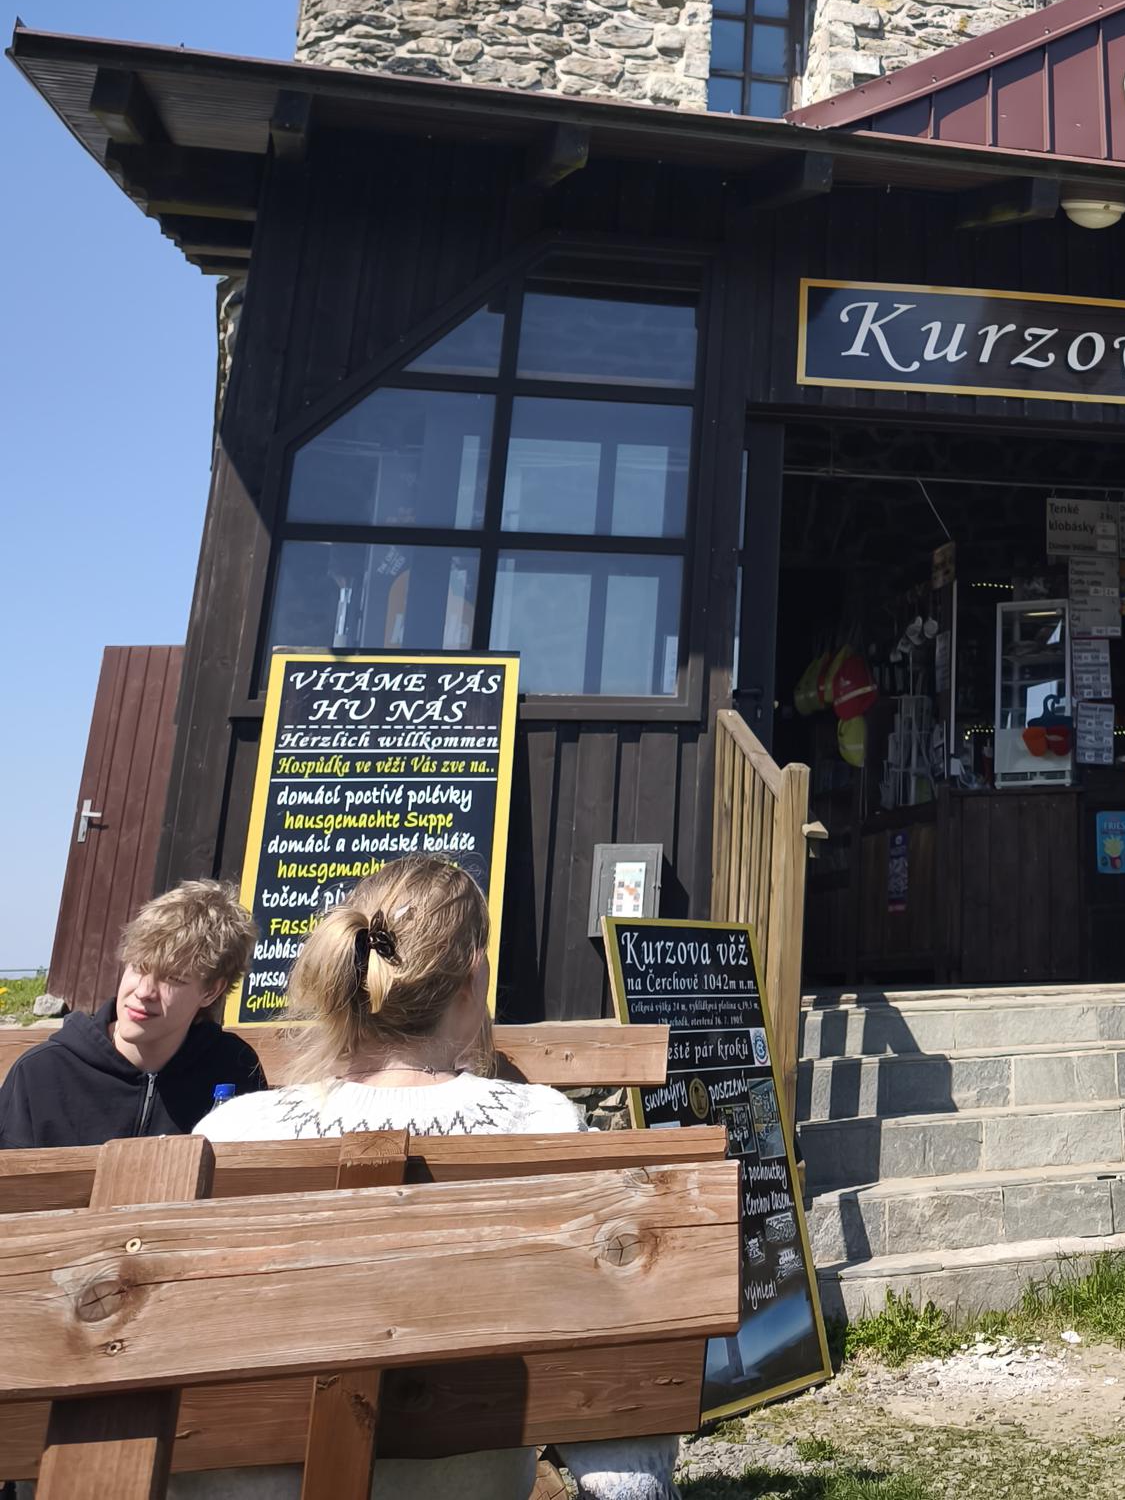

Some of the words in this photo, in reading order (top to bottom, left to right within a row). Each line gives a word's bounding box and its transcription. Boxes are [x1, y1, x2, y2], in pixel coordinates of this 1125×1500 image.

[289, 667, 426, 693] VÍTÁME
[438, 669, 501, 694] VÁS
[309, 698, 376, 720] HU
[386, 696, 467, 723] NÁS
[278, 732, 370, 748] Herzlich
[378, 732, 498, 750] willkommen
[276, 755, 350, 778] Hospůdka
[355, 761, 372, 773] ve
[376, 756, 406, 774] věži
[410, 756, 436, 773] Vás
[441, 761, 464, 773] zve
[277, 784, 340, 805] domácí
[345, 784, 402, 812] poctivé
[408, 786, 472, 812] polévky
[284, 810, 400, 834] hausgemachte
[404, 812, 454, 835] Suppe
[268, 834, 330, 854] domácí
[336, 839, 345, 852] a
[351, 834, 418, 852] chodské
[424, 833, 475, 851] koláče
[277, 860, 384, 884] hausgemacht
[262, 885, 318, 908] točené
[622, 932, 711, 971] Kurzova
[717, 935, 748, 965] věž
[627, 977, 642, 991] na
[646, 969, 698, 992] Čerchově
[739, 980, 756, 989] n.m.
[695, 1040, 714, 1064] pár
[717, 1037, 748, 1060] kroků
[645, 1079, 688, 1112] suvenýry
[709, 1070, 748, 1110] posezení
[749, 1159, 787, 1189] pochoutky
